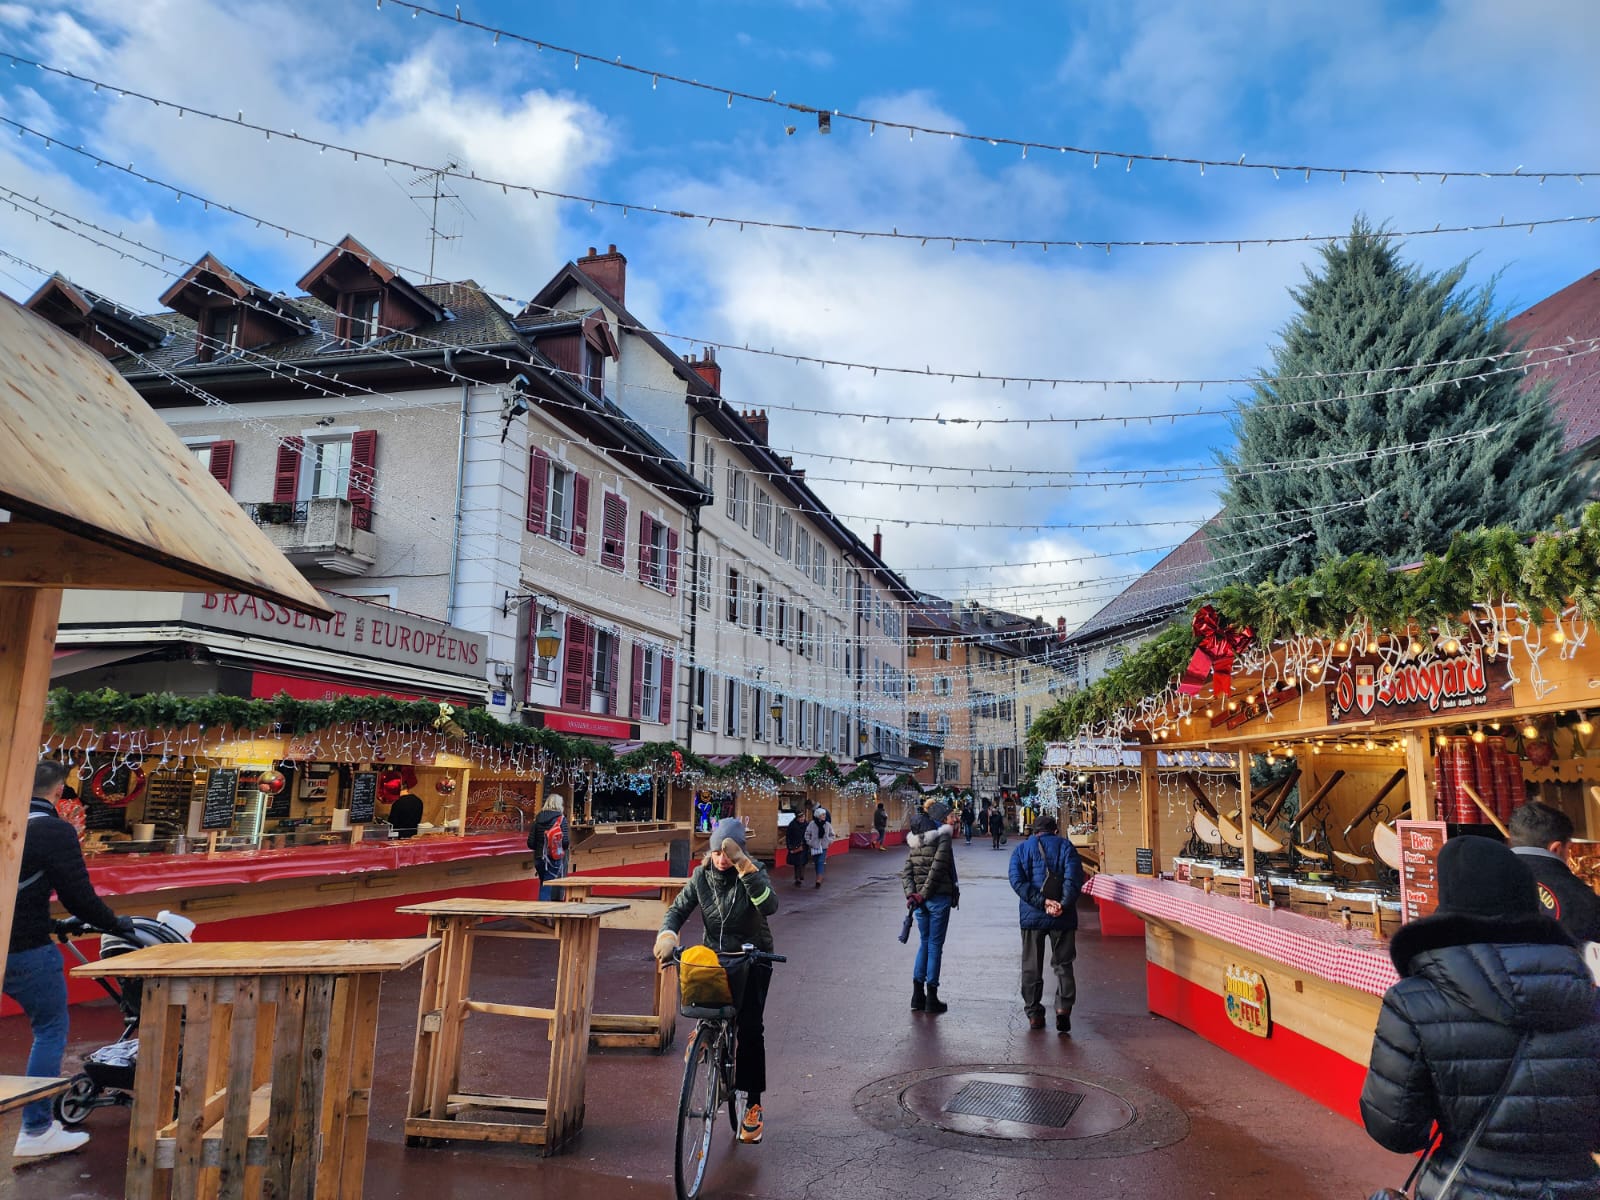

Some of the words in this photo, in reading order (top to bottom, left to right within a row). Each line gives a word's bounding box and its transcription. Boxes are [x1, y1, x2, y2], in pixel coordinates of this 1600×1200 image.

[202, 591, 347, 637] BRASSERIE
[354, 617, 366, 642] DES
[371, 620, 479, 664] EUROPÉENS
[1377, 646, 1487, 711] Savoyard
